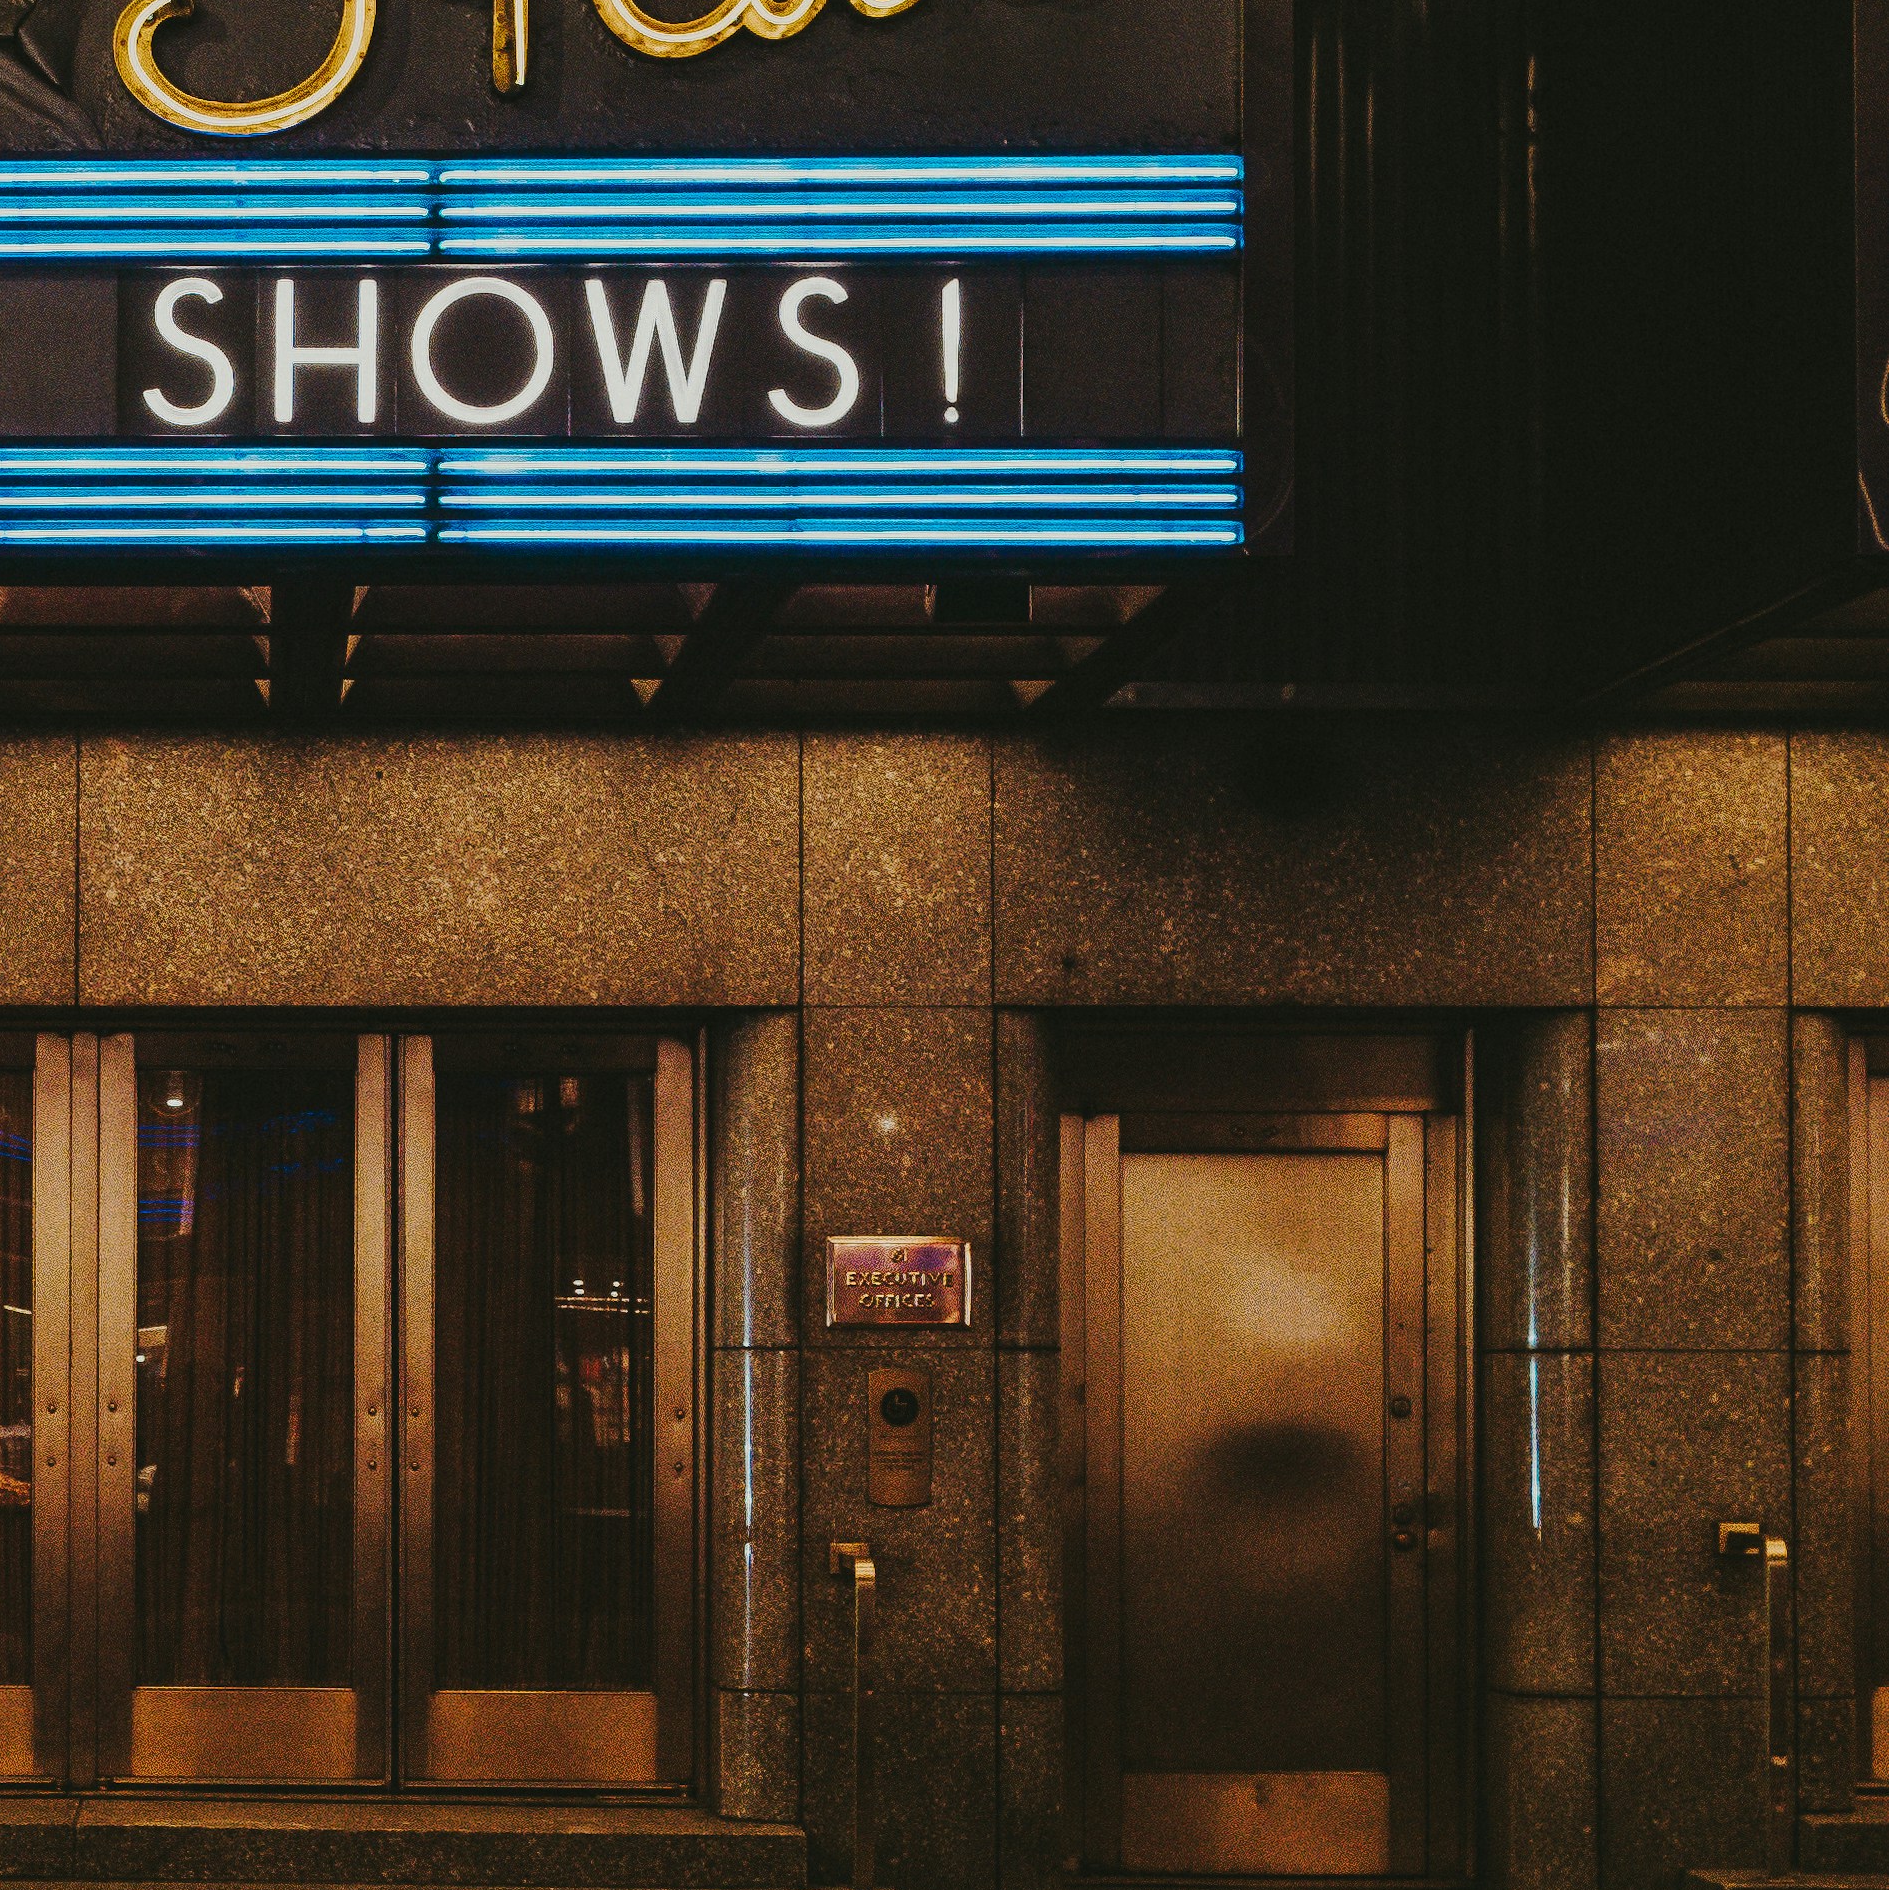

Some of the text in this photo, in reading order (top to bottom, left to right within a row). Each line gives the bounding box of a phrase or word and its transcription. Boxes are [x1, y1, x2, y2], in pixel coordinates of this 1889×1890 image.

[142, 277, 961, 428] SHOWS!
[845, 1271, 954, 1288] EXECUTIVE
[858, 1293, 936, 1309] OFFICES
